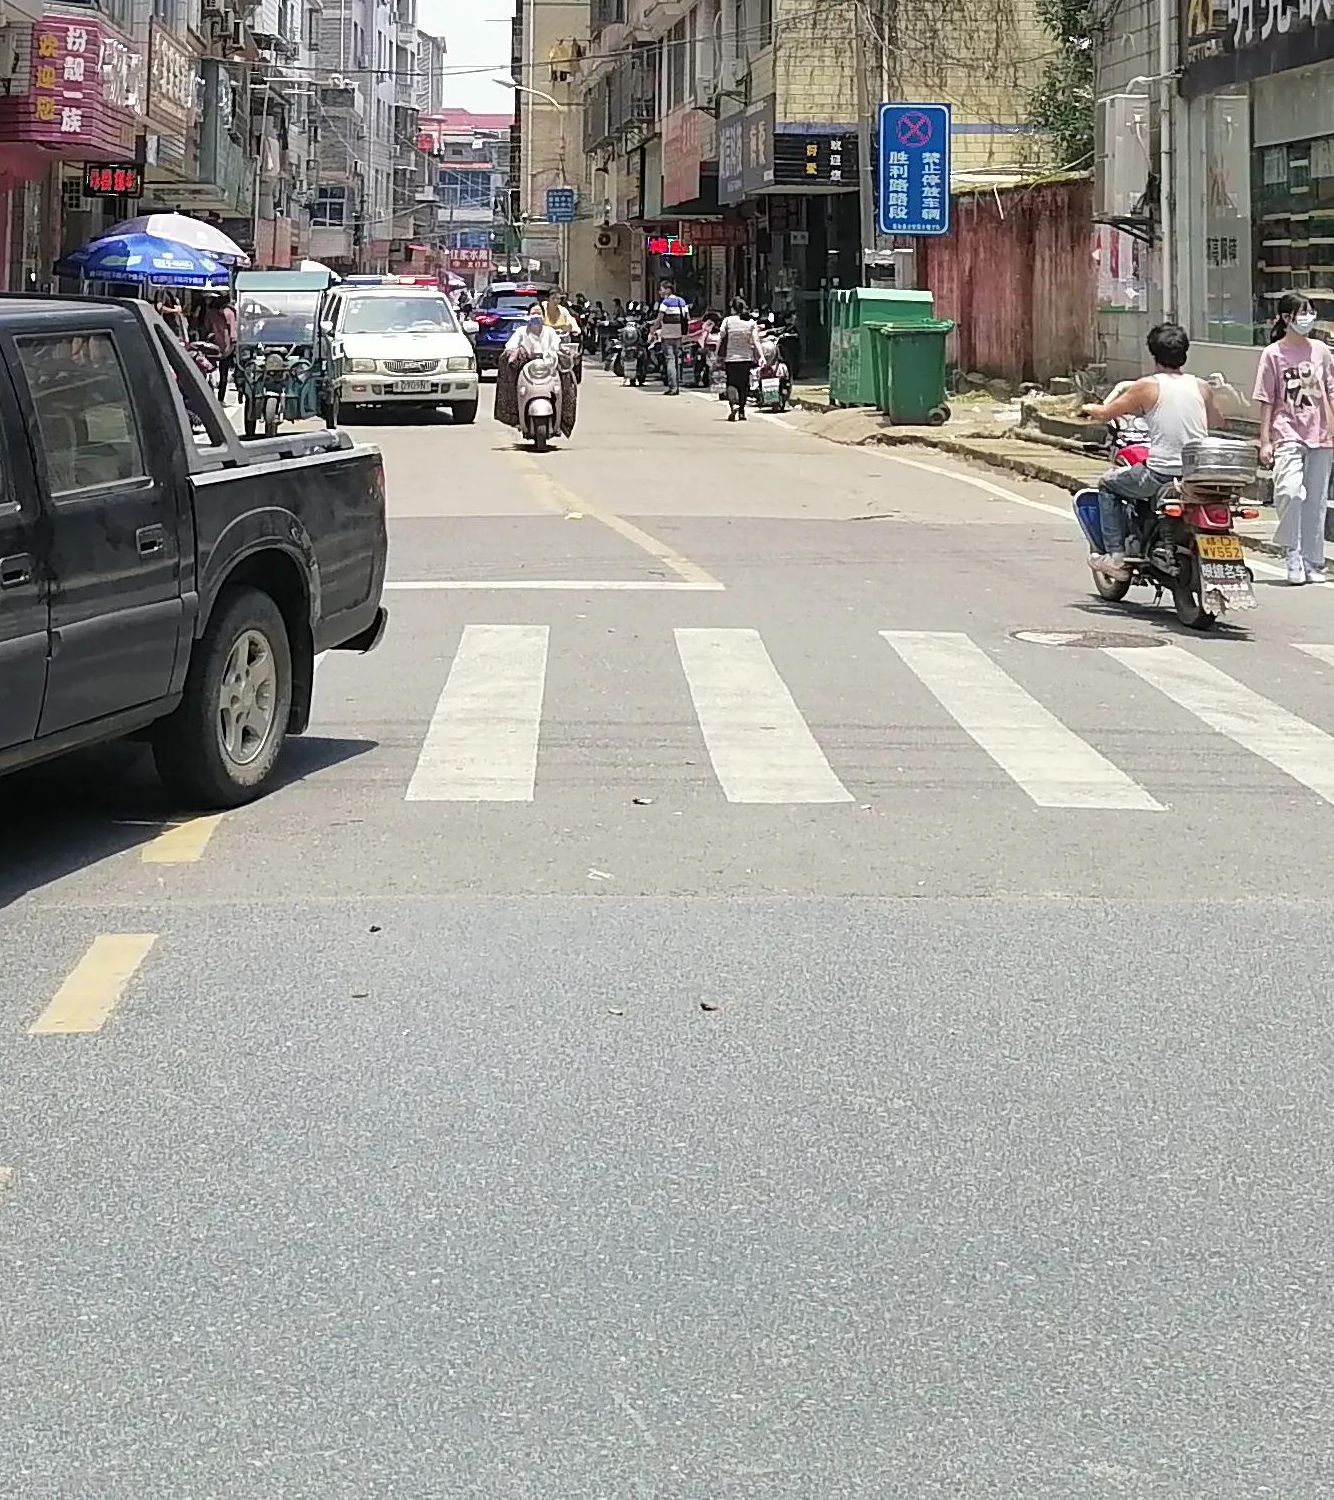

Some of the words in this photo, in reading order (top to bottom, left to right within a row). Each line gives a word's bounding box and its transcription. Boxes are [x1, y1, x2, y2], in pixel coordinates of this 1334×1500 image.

[61, 26, 88, 133] 扮靓一族
[888, 151, 909, 219] 胜利路路段
[921, 152, 941, 220] 禁止停放车辆
